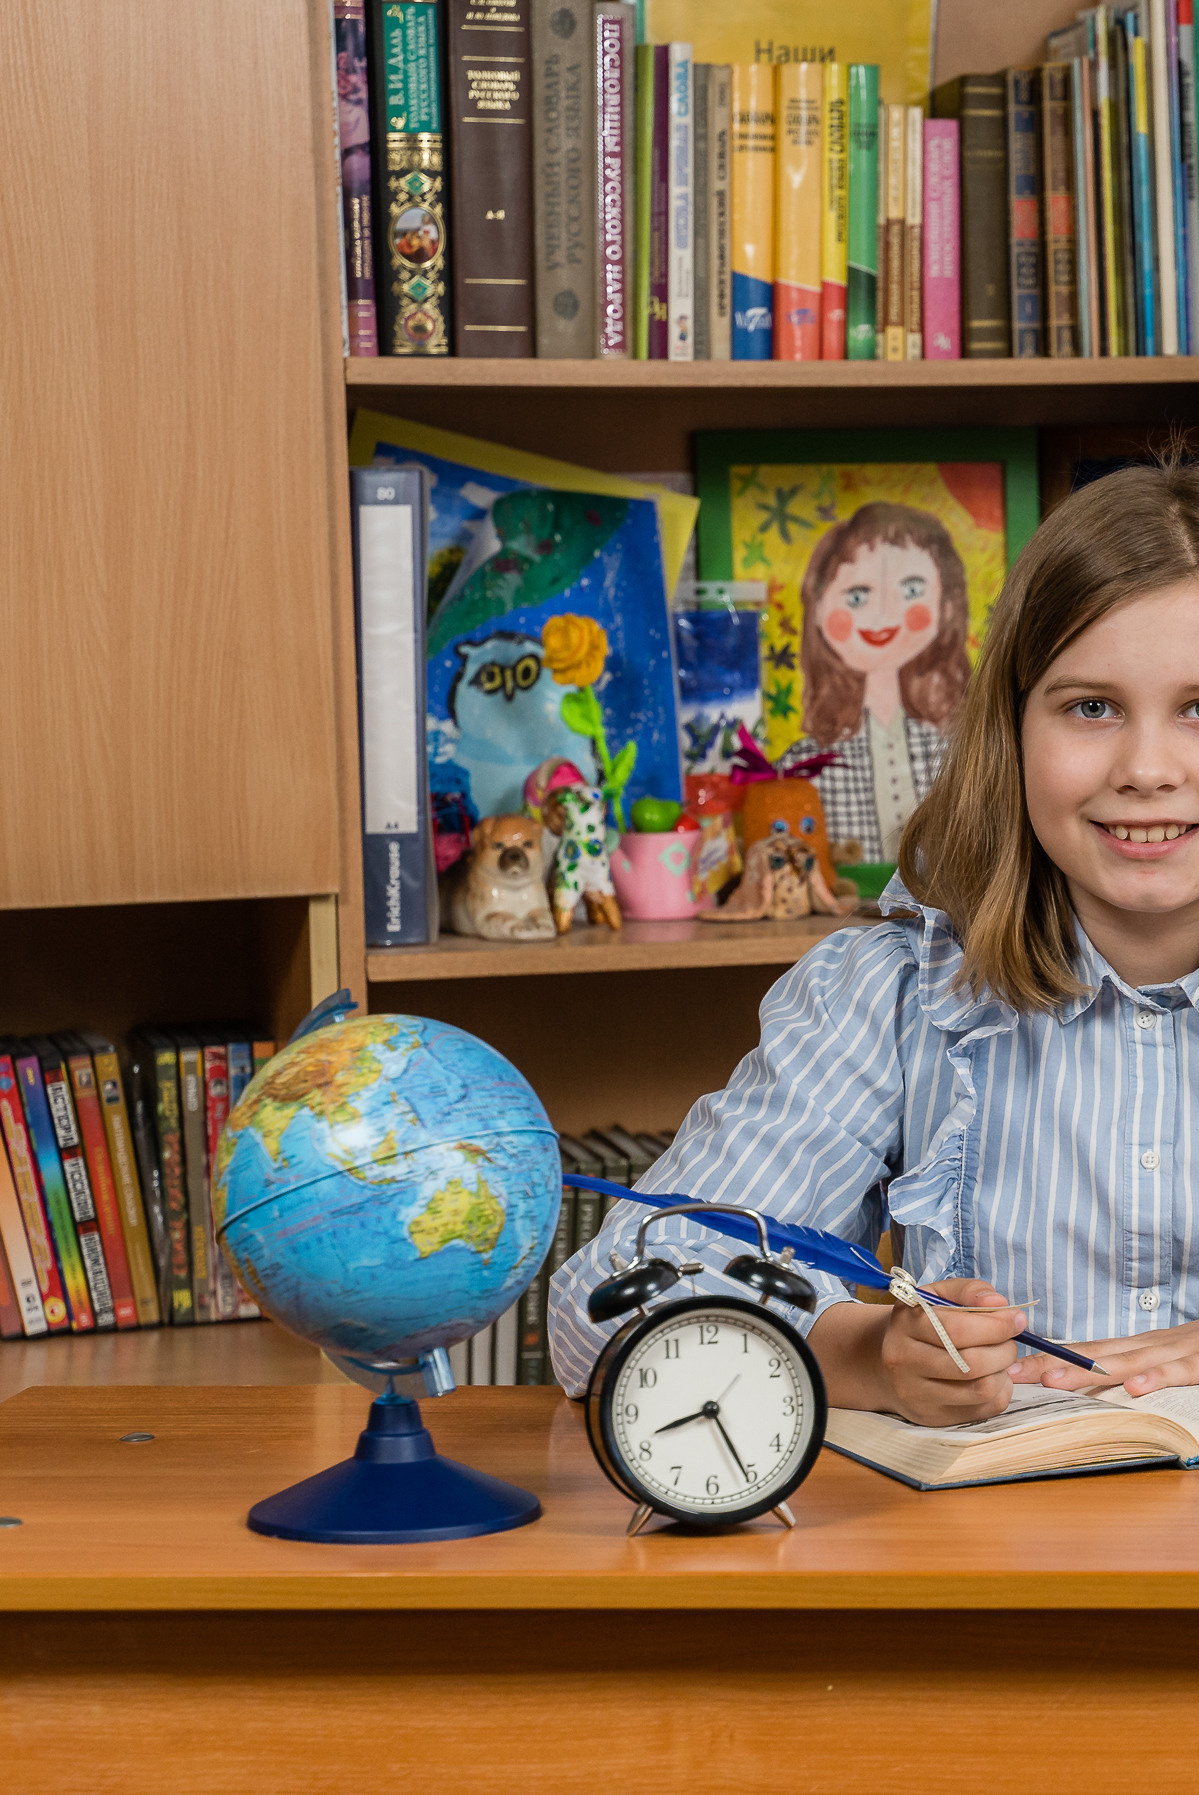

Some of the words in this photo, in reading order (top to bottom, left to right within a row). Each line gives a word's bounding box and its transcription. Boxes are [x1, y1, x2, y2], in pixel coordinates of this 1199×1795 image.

[754, 39, 836, 63] Наши
[602, 22, 621, 154] ПОСЛОВИЦЫ
[542, 53, 562, 156] СЛОВАРЬ
[564, 61, 582, 140] ЯЗЫКА
[564, 146, 586, 266] РУССКОГО
[604, 156, 622, 262] РУССКОГО
[605, 264, 623, 347] НАРОДА
[386, 841, 400, 932] ErichKrause
[698, 1324, 719, 1345] 12
[741, 1333, 750, 1354] 1
[664, 1338, 680, 1360] 11
[638, 1367, 658, 1389] 10
[768, 1358, 782, 1379] 2
[624, 1403, 639, 1425] 9
[782, 1395, 795, 1417] 3
[638, 1440, 653, 1462] 8
[769, 1432, 784, 1453] 4
[669, 1465, 682, 1486] 7
[745, 1463, 758, 1484] 5
[705, 1475, 720, 1496] 6
